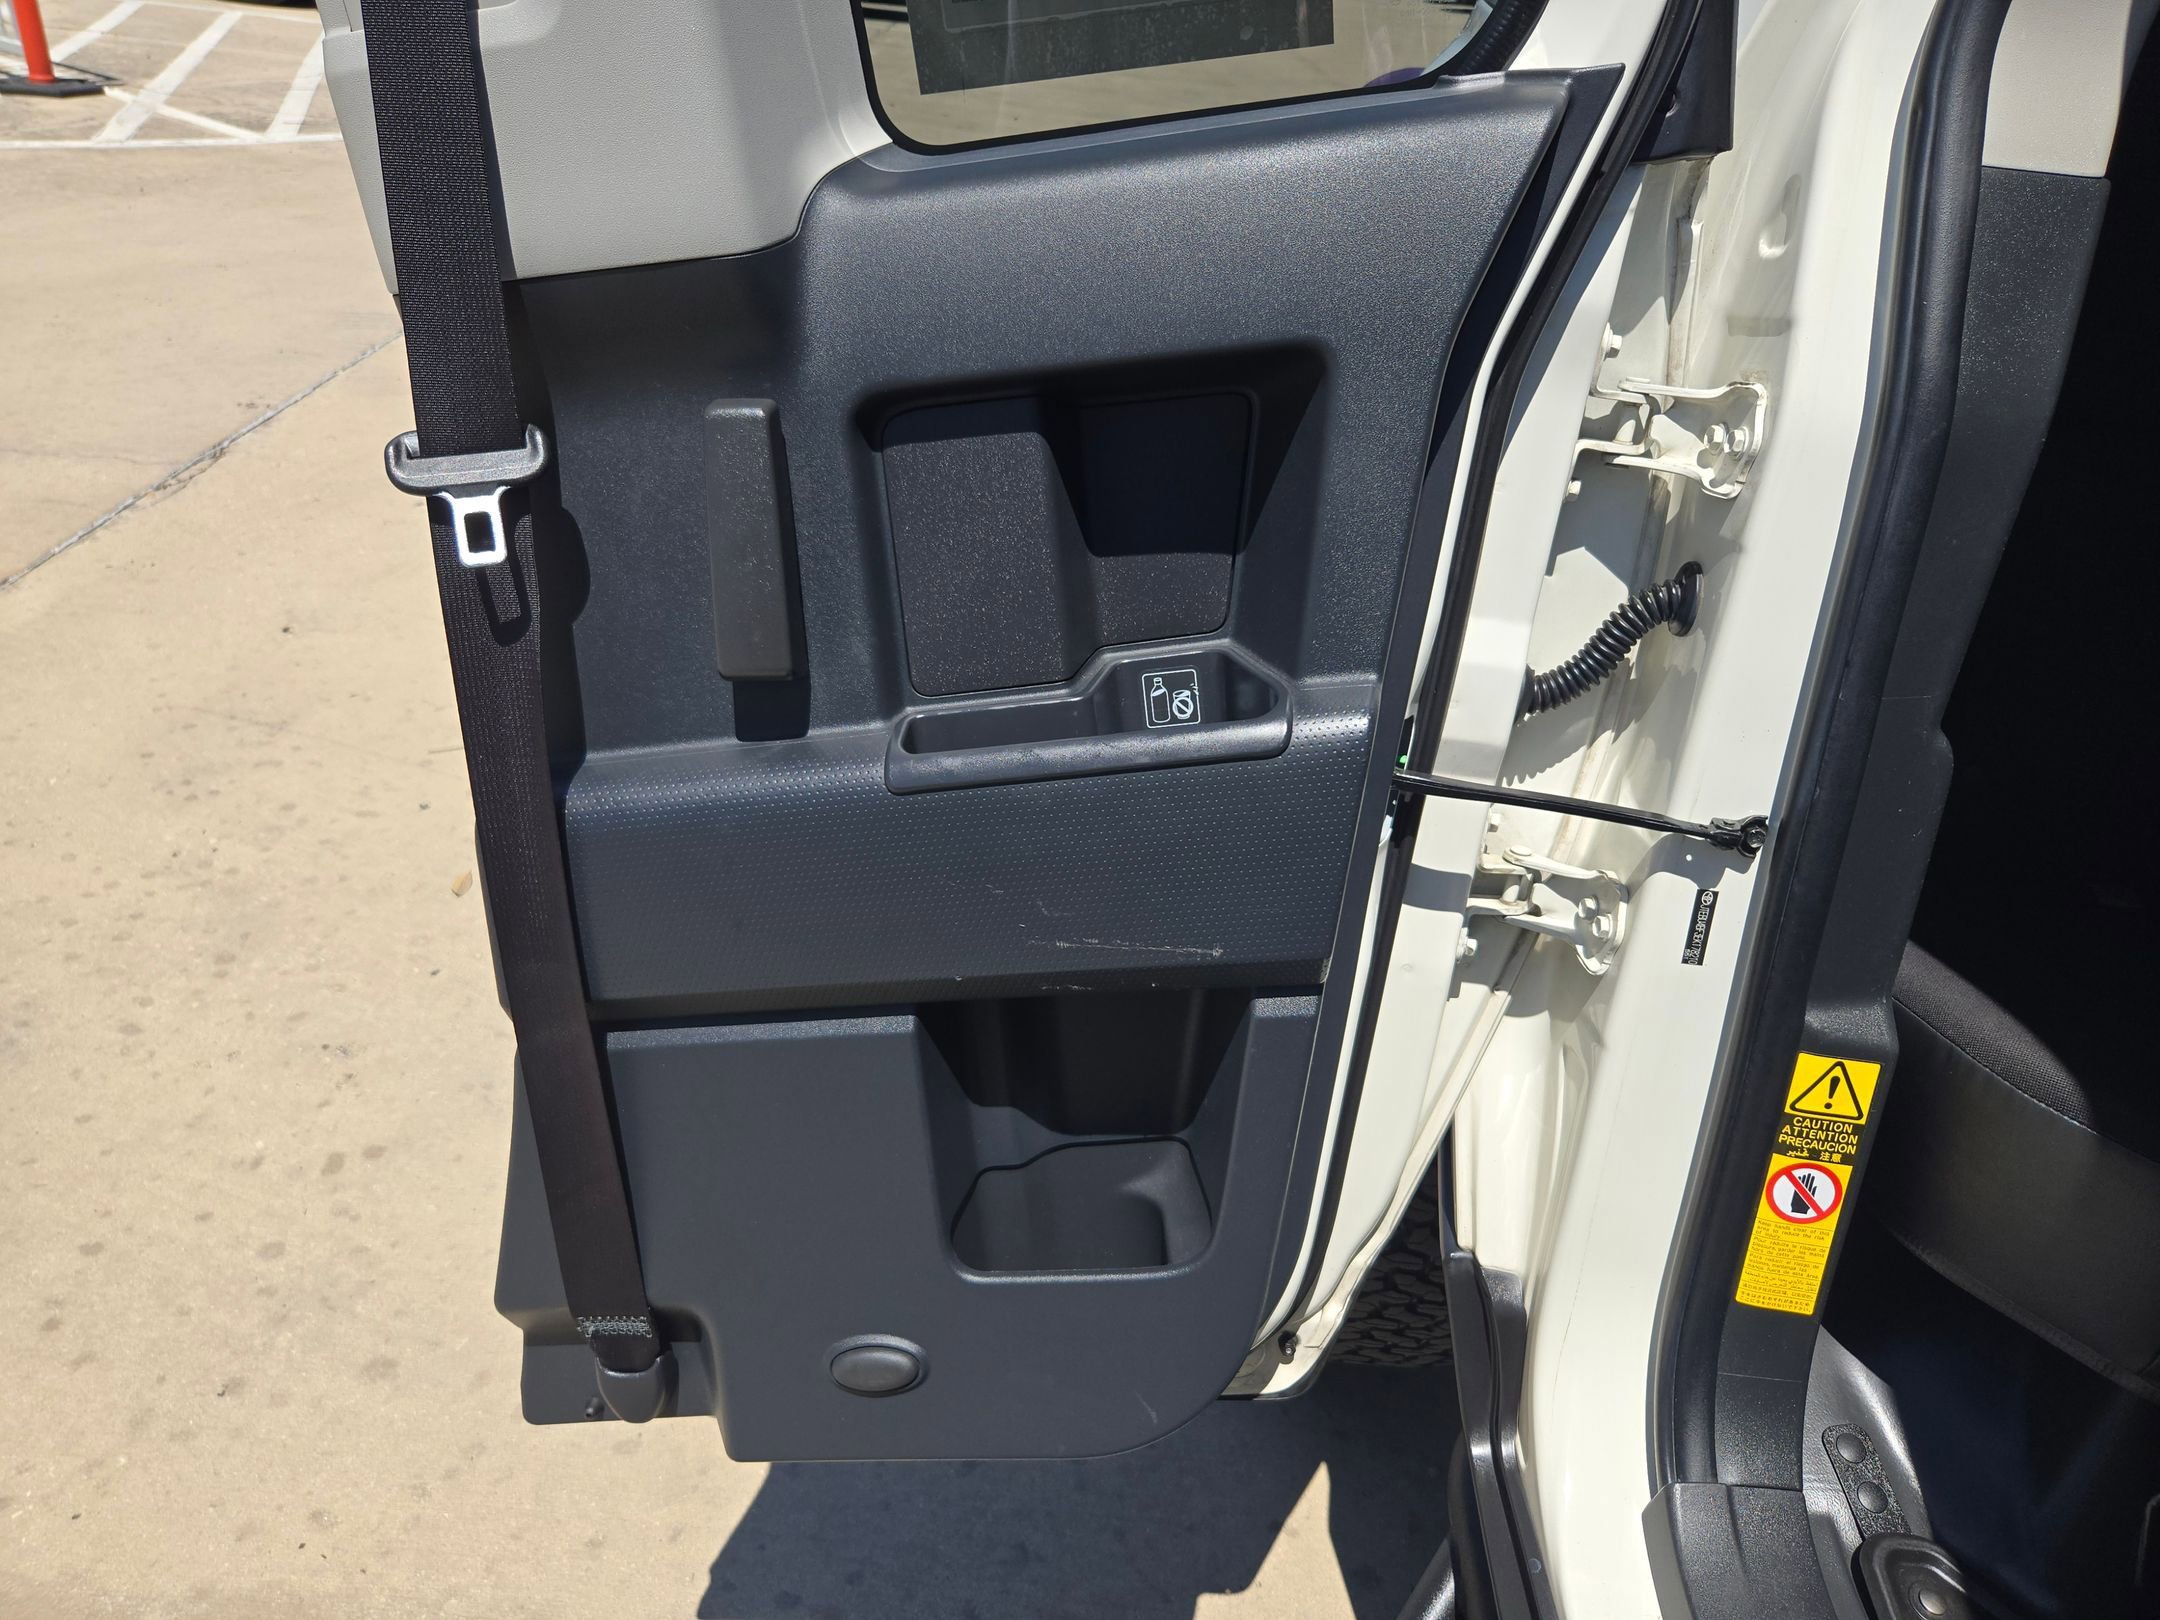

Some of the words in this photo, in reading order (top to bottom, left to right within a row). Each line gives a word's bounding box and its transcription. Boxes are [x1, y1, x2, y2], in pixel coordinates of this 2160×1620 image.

[1782, 1125, 1858, 1144] ATTENTION
[1793, 1117, 1853, 1133] CAUTION
[1778, 1134, 1856, 1154] PRECAUCION
